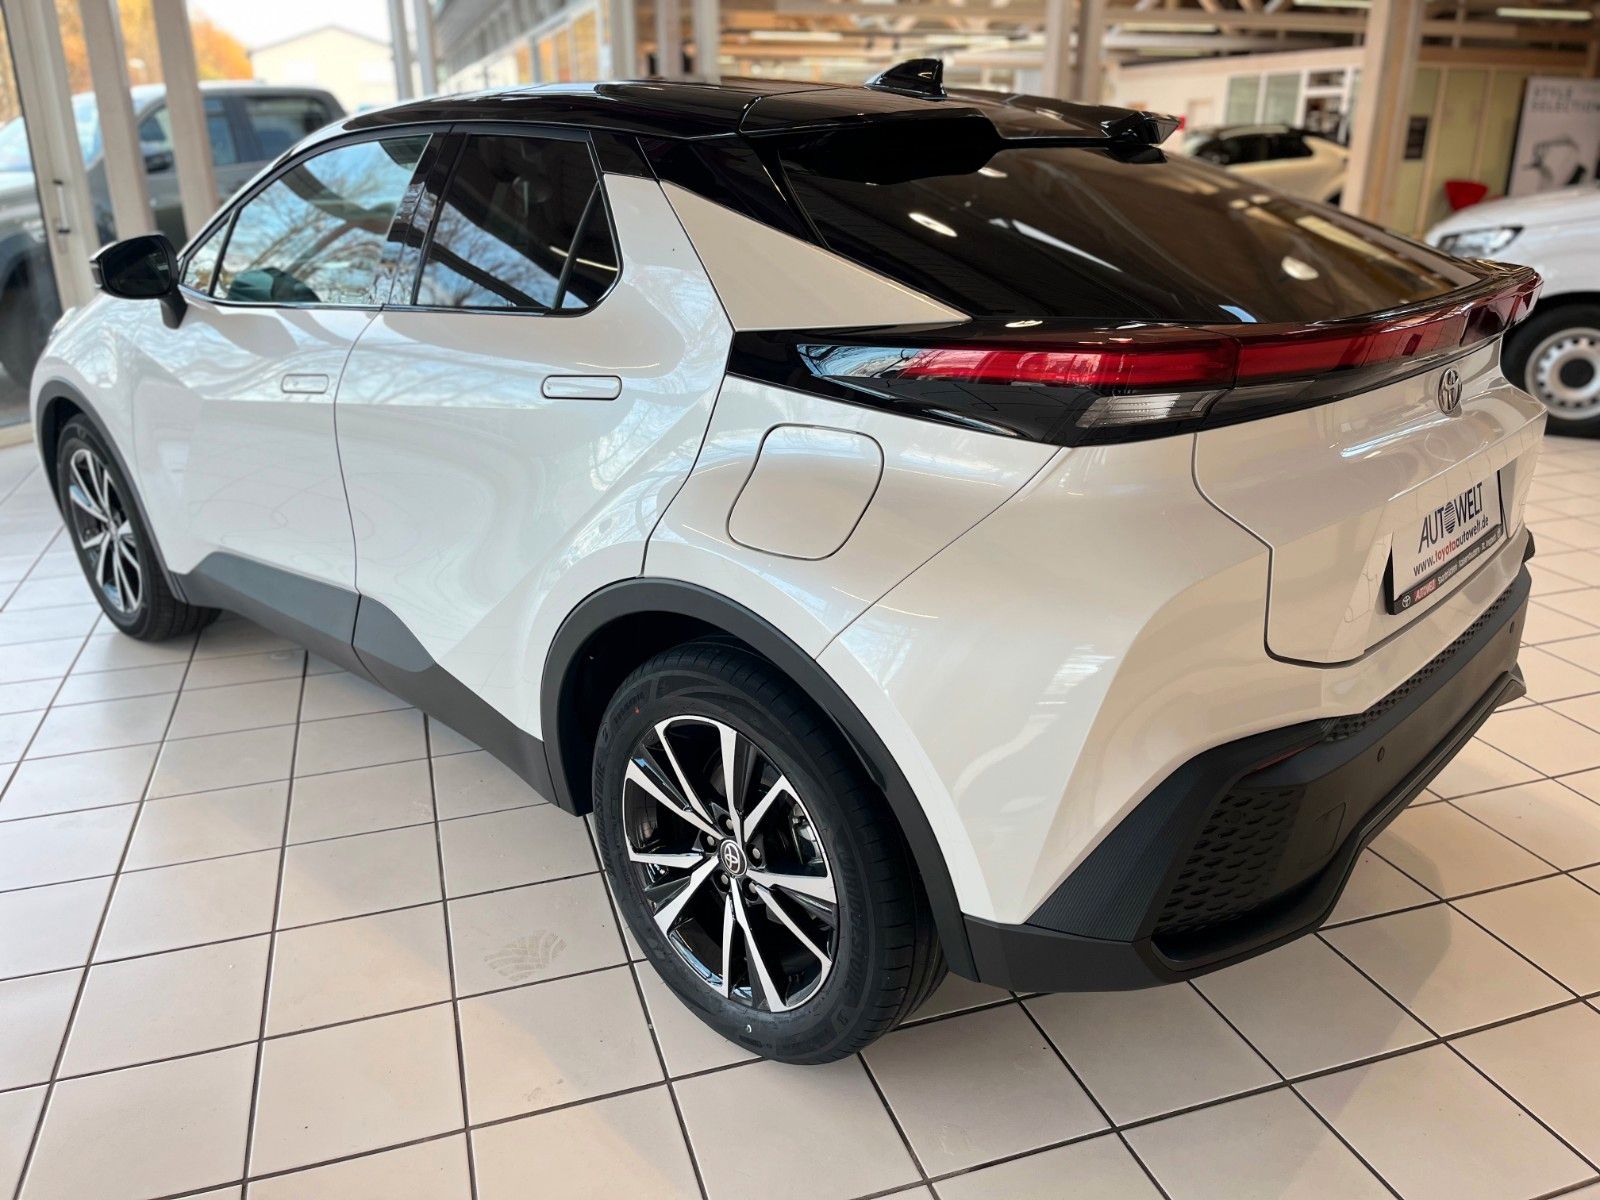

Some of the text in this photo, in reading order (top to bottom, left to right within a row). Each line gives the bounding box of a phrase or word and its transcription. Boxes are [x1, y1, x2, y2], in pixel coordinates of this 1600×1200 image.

[1533, 86, 1572, 97] STYLE
[1413, 514, 1489, 577] www.toyotaautowelt.de
[1417, 481, 1483, 554] AUTOWELT
